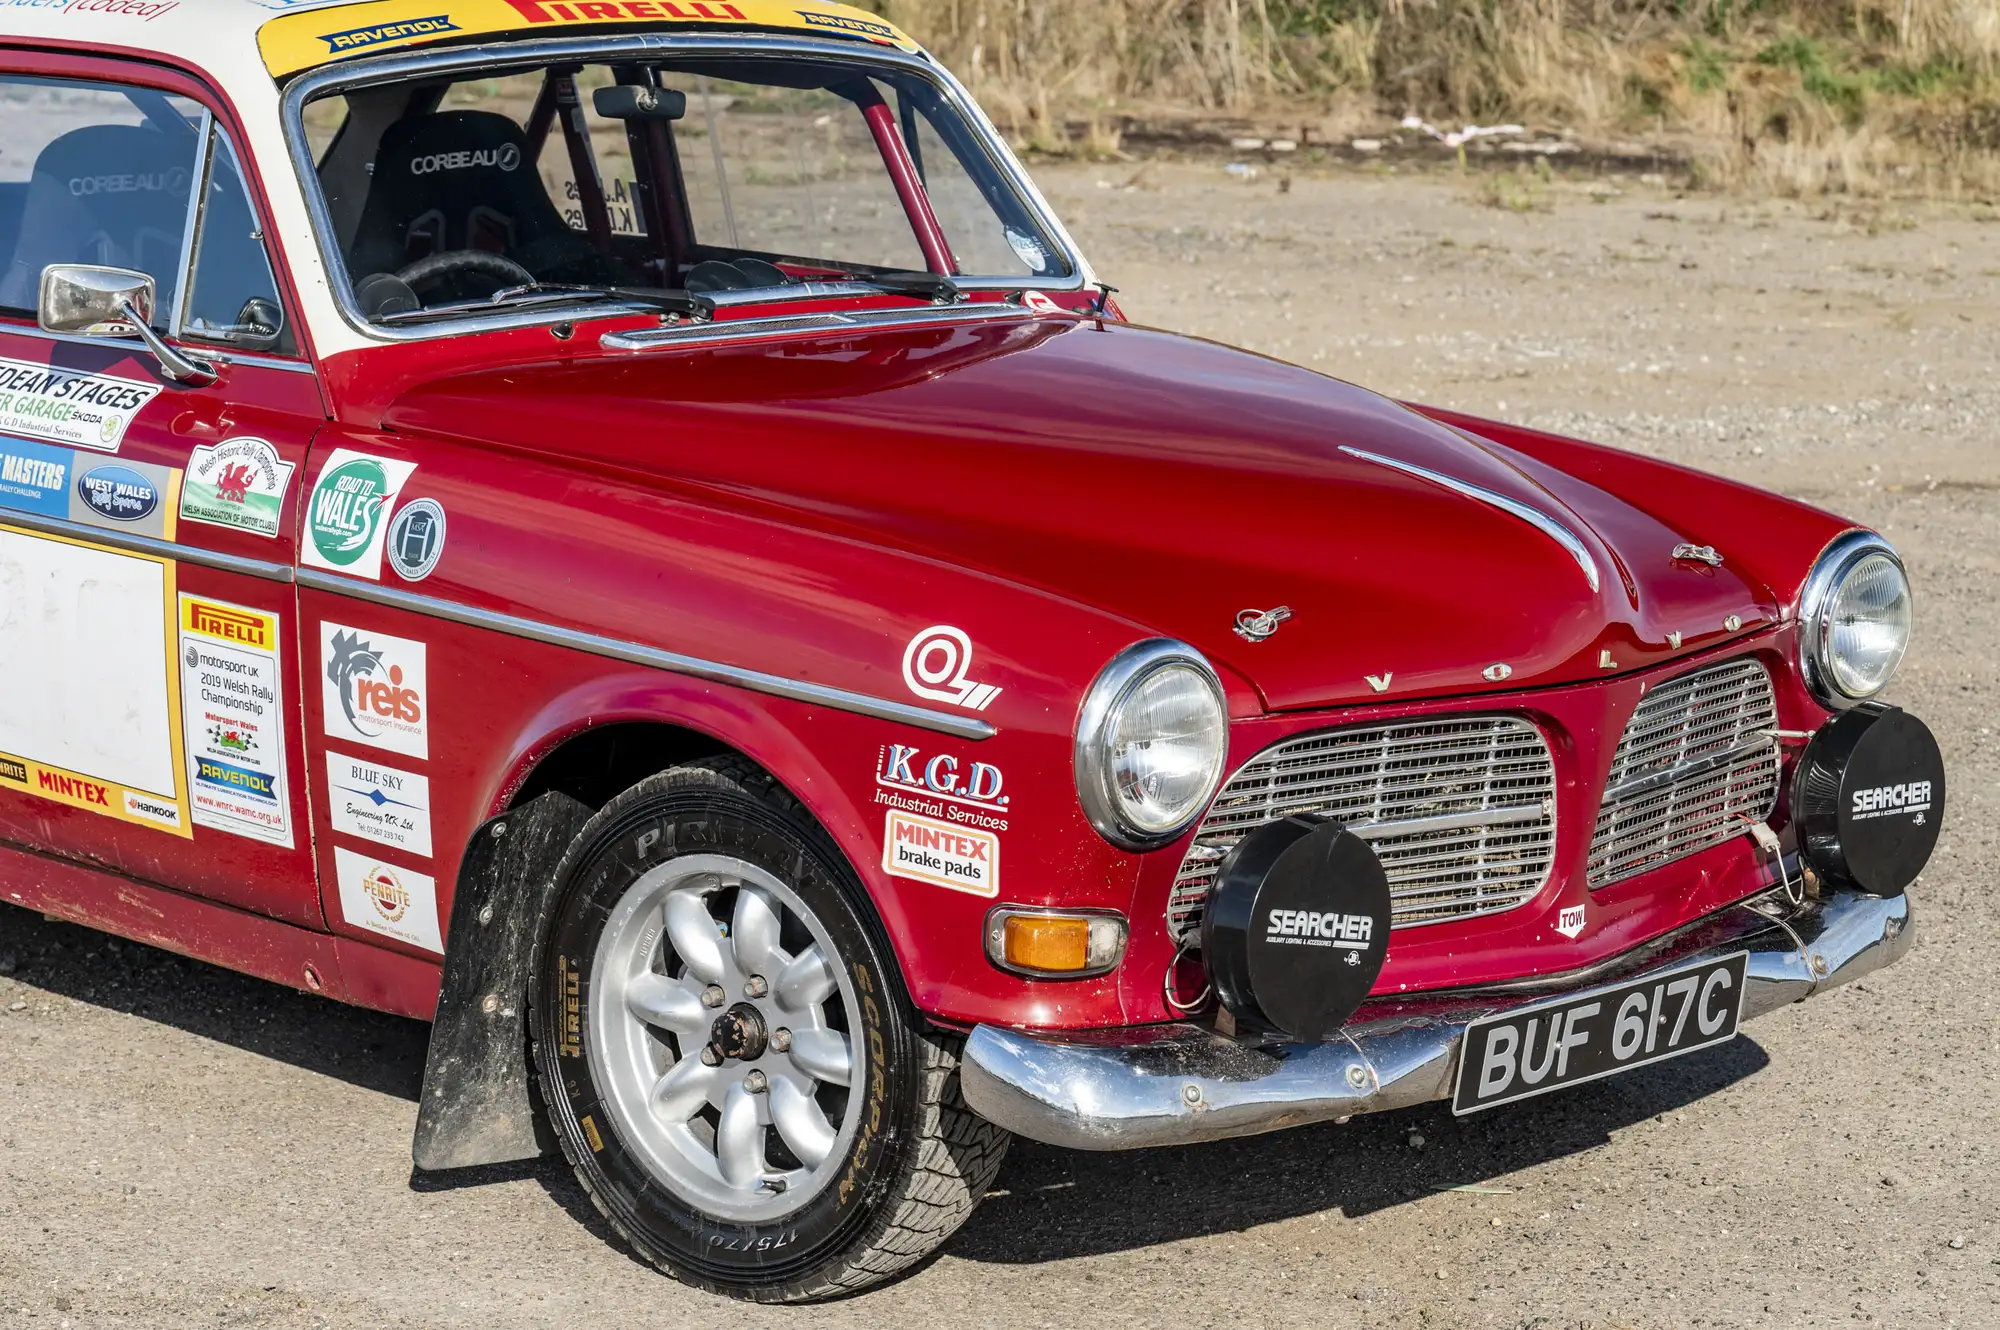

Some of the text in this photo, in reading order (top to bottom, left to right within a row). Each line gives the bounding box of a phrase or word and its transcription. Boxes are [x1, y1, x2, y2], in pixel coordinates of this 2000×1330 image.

[509, 0, 748, 23] PIRELLI
[805, 14, 893, 37] RAVENOL
[332, 19, 449, 48] RAVENOL
[411, 150, 497, 175] CORBEAU
[69, 174, 164, 196] CORBEAU
[54, 378, 150, 410] STAGES
[14, 396, 76, 422] GARAGE
[18, 420, 53, 434] Industrial
[53, 426, 82, 439] Services
[1, 455, 65, 491] MASTERS
[198, 455, 217, 476] Welsh
[217, 445, 241, 462] Historic
[85, 477, 151, 500] WEST WALES
[335, 475, 376, 496] ROAD TO
[315, 488, 382, 541] WALES
[191, 603, 264, 645] PIRELLI
[200, 654, 247, 675] motorsport
[200, 672, 274, 703] 2019 Welsh Rally
[201, 688, 263, 716] Championship
[358, 664, 421, 723] reis
[205, 712, 258, 732] Motorsport Wales
[358, 714, 422, 735] motorsport insurance
[38, 768, 108, 806] MINTEX
[201, 763, 269, 792] RAVENOL
[351, 765, 403, 791] BLUE SKY
[874, 789, 1009, 831] Industrial Services
[1852, 780, 1931, 812] SEARCHER
[346, 802, 383, 825] Engineering
[400, 819, 414, 831] Ltd
[896, 821, 987, 862] MINTEX
[899, 846, 981, 879] brake pads
[363, 879, 410, 907] PENRITE
[1267, 909, 1373, 940] SEARCHER
[1562, 910, 1583, 928] TOW
[1477, 968, 1732, 1098] BUF 617C
